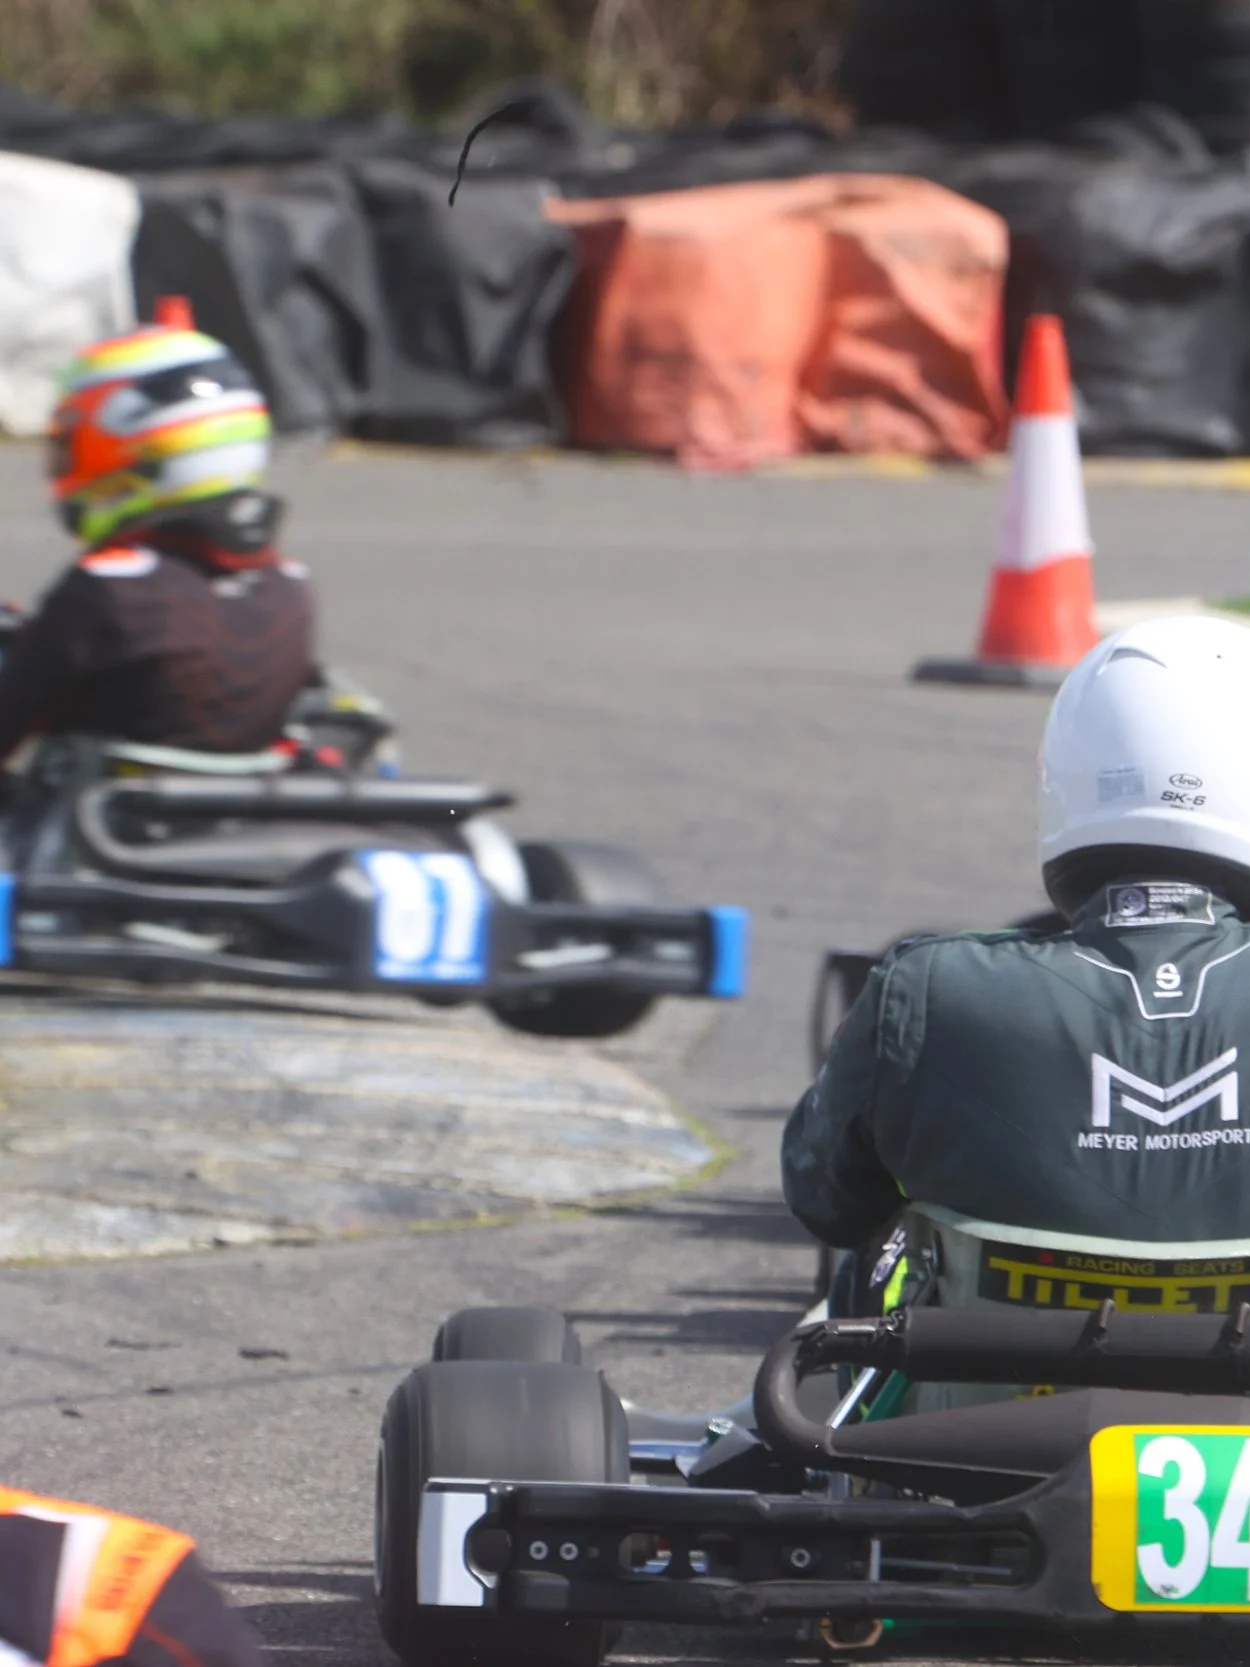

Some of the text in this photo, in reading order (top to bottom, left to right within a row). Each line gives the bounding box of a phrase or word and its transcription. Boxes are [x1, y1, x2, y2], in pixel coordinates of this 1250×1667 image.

[1160, 790, 1207, 806] SK-6
[1078, 1132, 1139, 1151] MEYER
[1066, 1254, 1245, 1276] RACING SEATS
